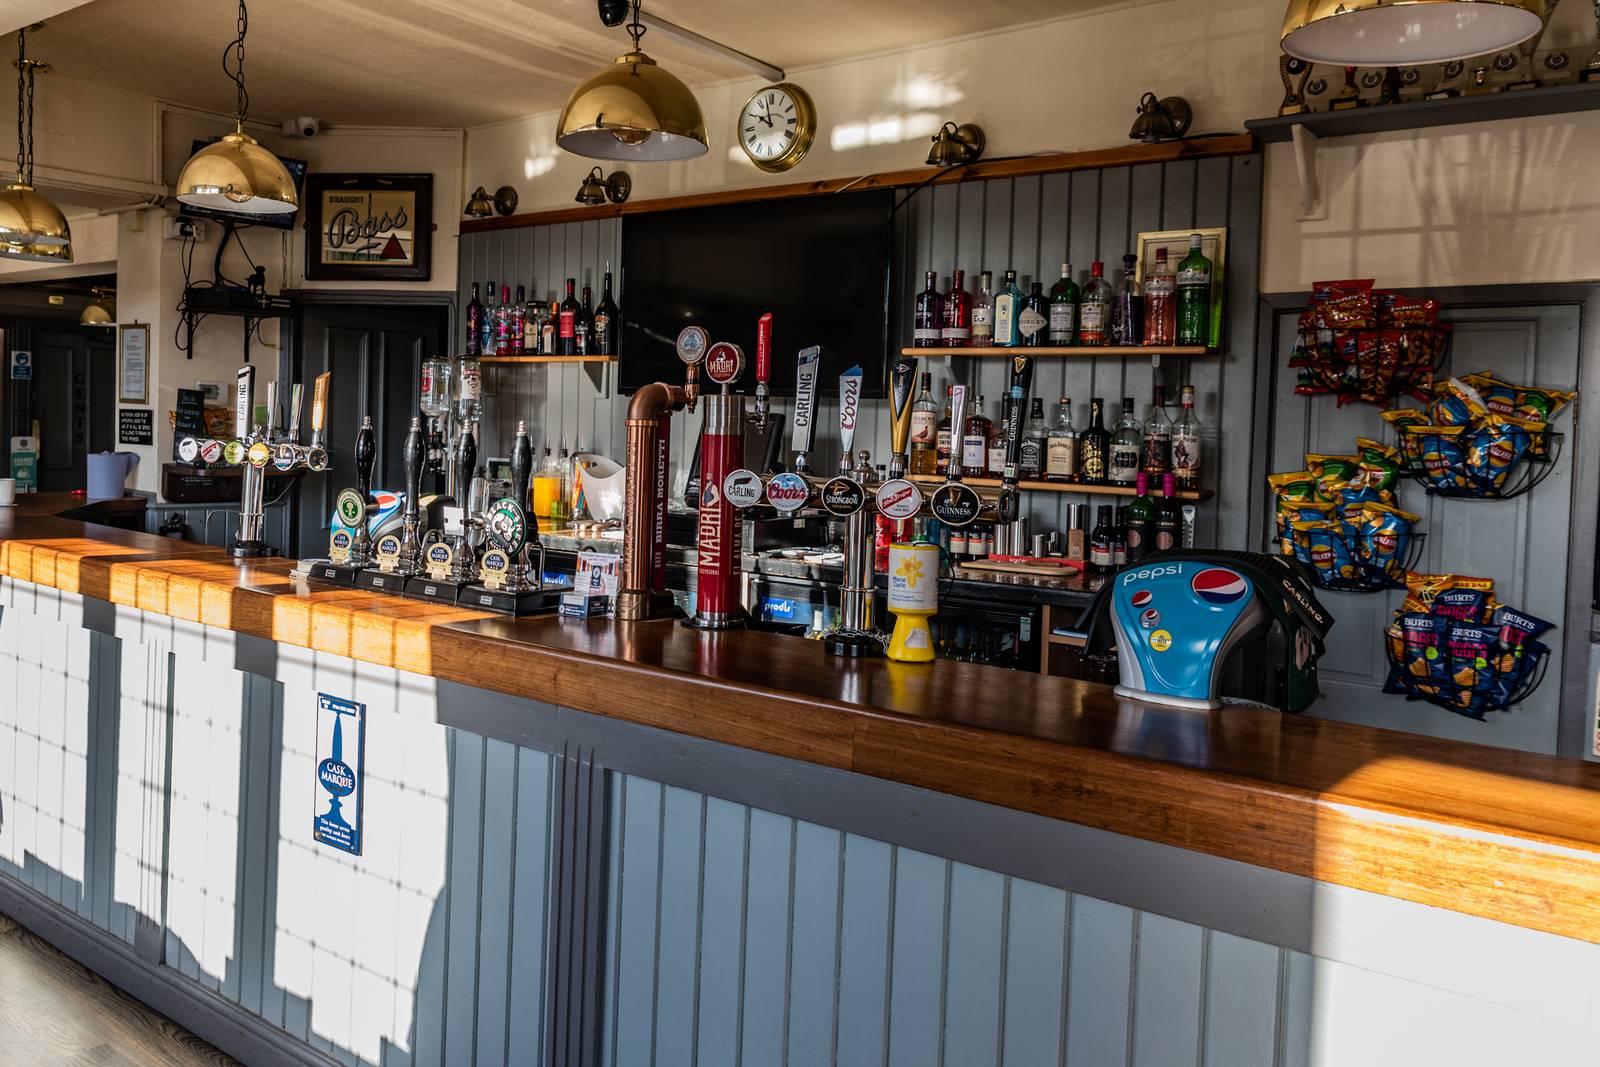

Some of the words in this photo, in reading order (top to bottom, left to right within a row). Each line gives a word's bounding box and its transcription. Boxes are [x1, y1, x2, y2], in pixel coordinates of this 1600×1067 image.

[329, 195, 364, 204] DRAUGHT
[327, 205, 407, 248] Bass
[73, 371, 87, 444] GENTS
[796, 373, 812, 427] CARLING
[841, 378, 858, 430] Coors
[1008, 406, 1018, 441] GUINNESS
[657, 439, 666, 498] MORETTI
[728, 486, 756, 498] CARLING
[768, 482, 808, 500] Coors
[826, 493, 858, 505] STRONGBOW
[936, 505, 972, 516] GUINNESS
[656, 502, 664, 544] BIRRA
[1123, 563, 1183, 587] pepsi
[764, 600, 791, 612] prodis
[1443, 593, 1476, 602] BURTS
[1404, 617, 1434, 628] BURTS
[1502, 611, 1536, 630] BURTS
[1452, 627, 1482, 639] BURTS
[326, 762, 346, 777] CASK
[321, 770, 353, 789] MARQUE
